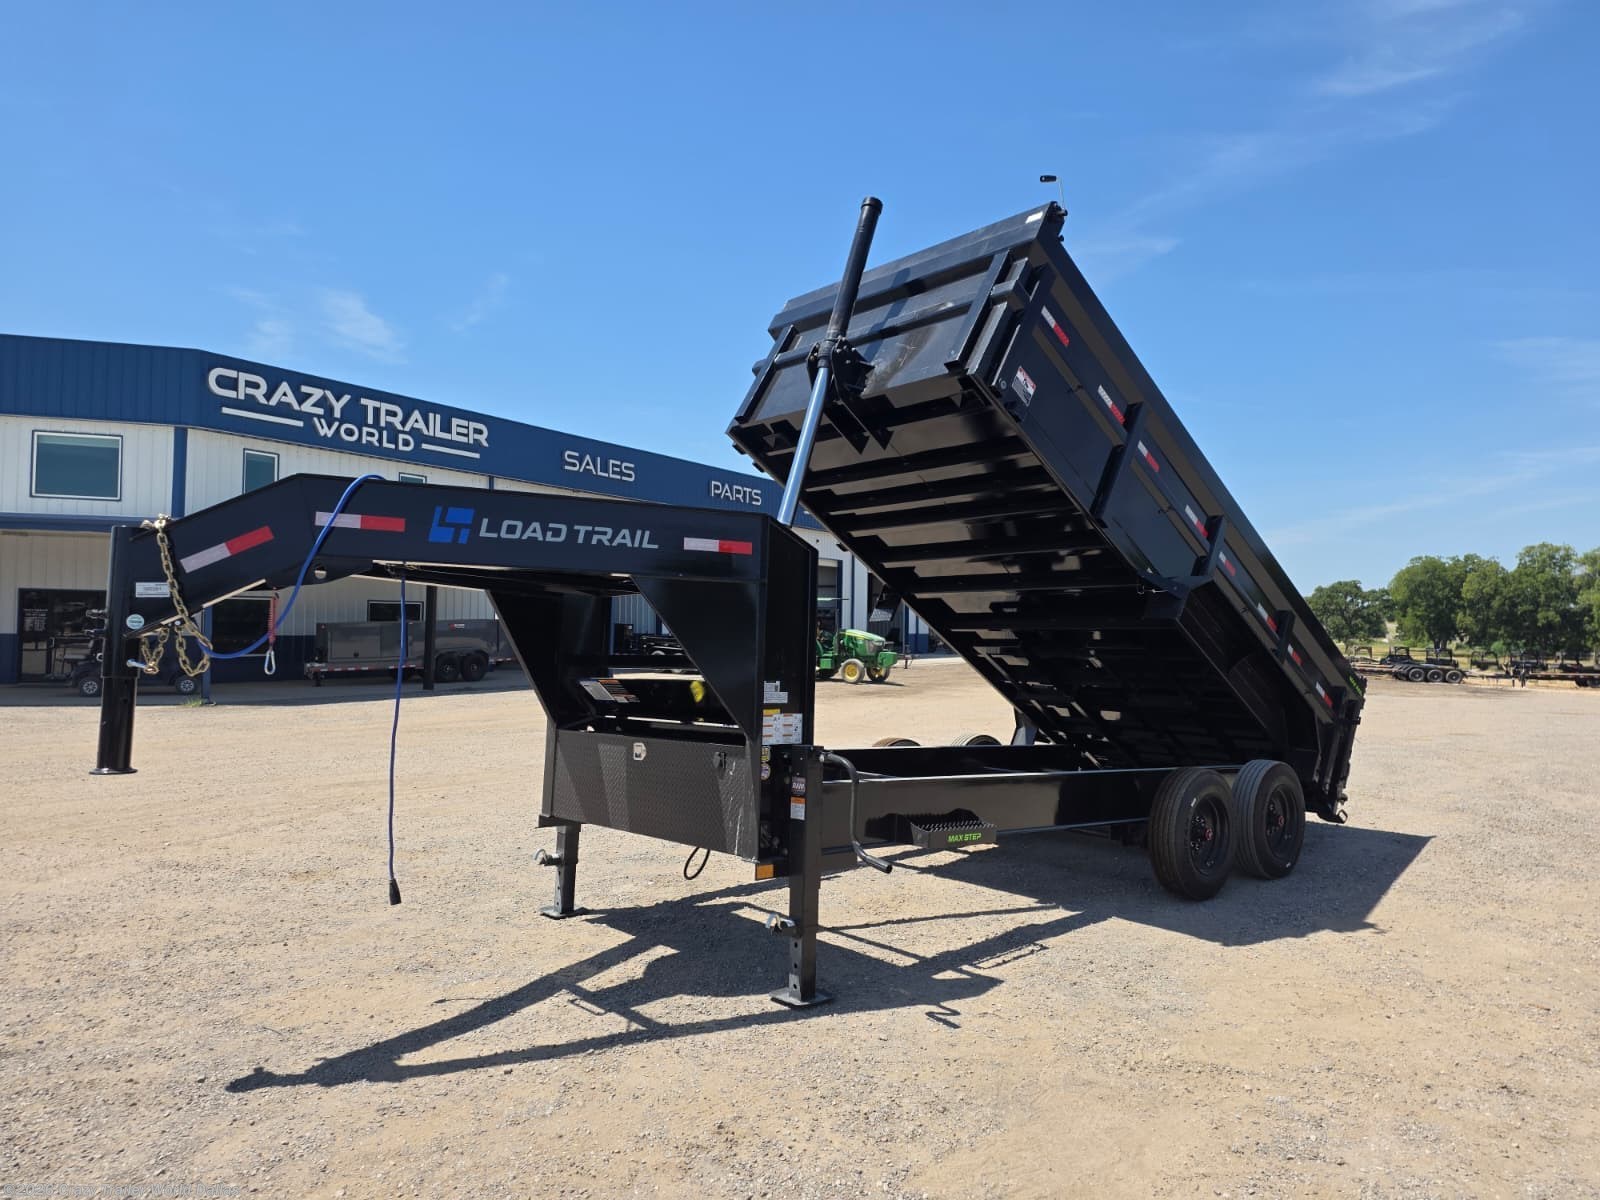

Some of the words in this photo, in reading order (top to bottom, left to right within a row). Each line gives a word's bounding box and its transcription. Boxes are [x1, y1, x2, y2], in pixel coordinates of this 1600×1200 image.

[208, 367, 351, 418] CRAZY
[360, 397, 489, 448] TRAILER
[312, 417, 414, 451] WORLD
[564, 450, 635, 482] SALES
[711, 480, 762, 506] PARTS
[479, 518, 567, 542] LOAD
[574, 524, 659, 549] TRAIL
[963, 832, 982, 841] STEP
